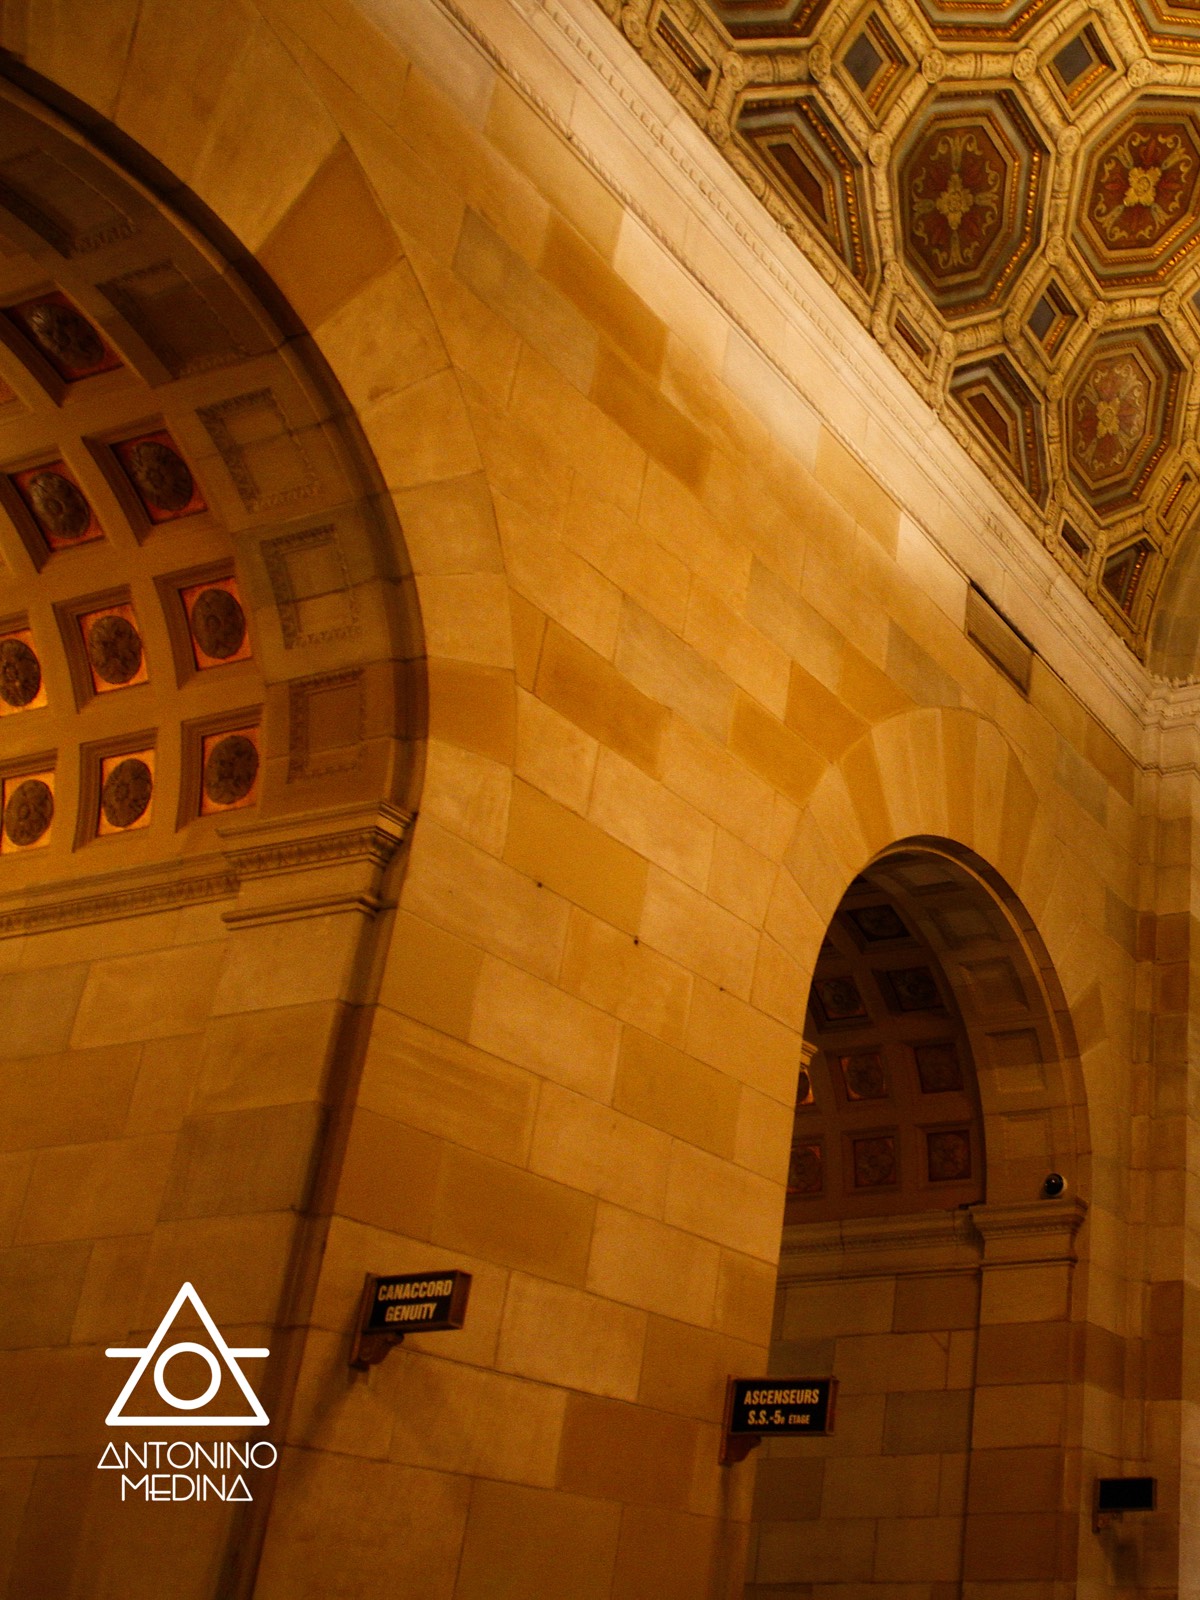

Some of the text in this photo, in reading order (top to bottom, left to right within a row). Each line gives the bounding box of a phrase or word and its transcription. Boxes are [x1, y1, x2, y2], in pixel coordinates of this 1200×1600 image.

[378, 1280, 453, 1301] CANACCORD
[385, 1303, 437, 1322] GENUITY
[744, 1389, 819, 1405] ASCENSEURS
